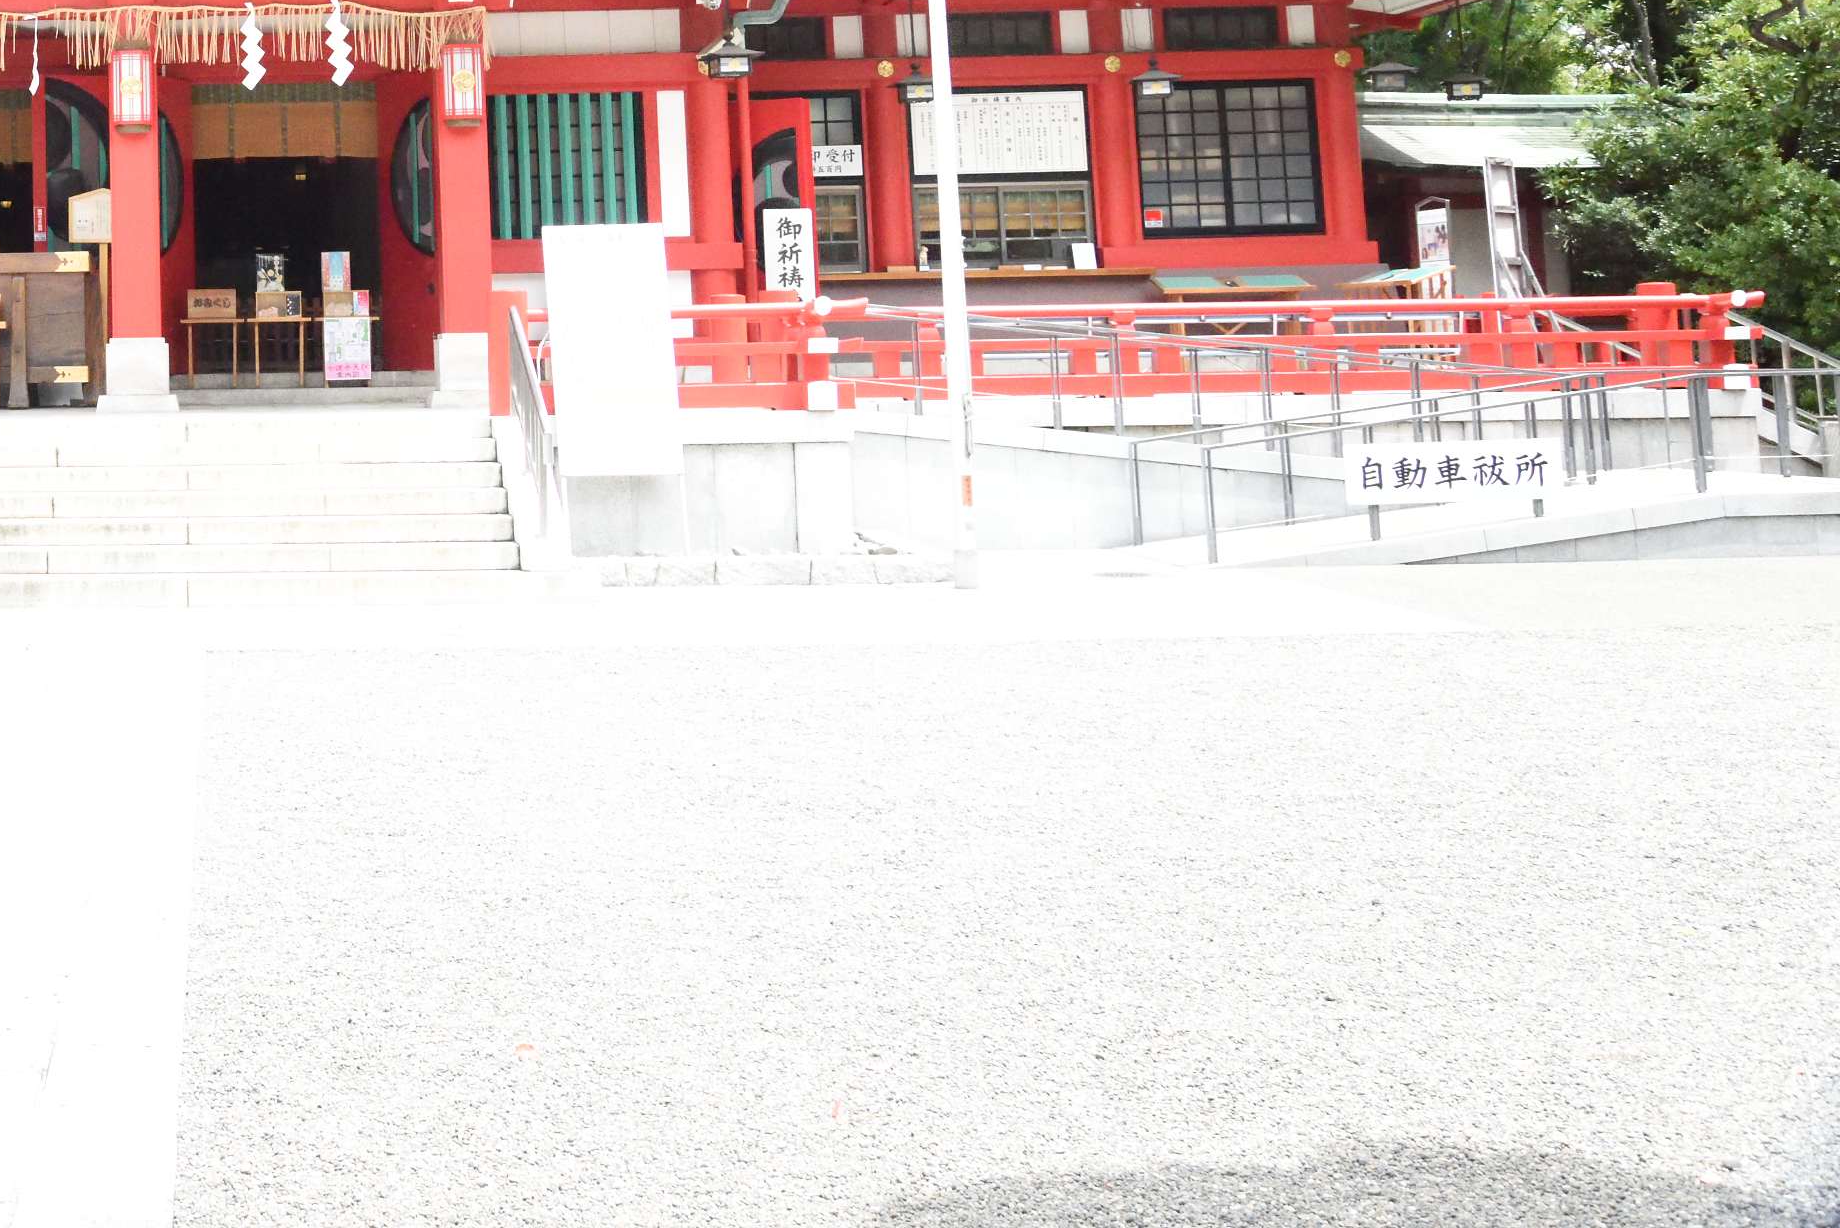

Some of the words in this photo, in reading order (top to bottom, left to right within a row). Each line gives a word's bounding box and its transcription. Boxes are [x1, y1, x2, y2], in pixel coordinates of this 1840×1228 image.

[775, 216, 804, 301] 御祈祷
[1361, 451, 1548, 490] 自動車祓所
